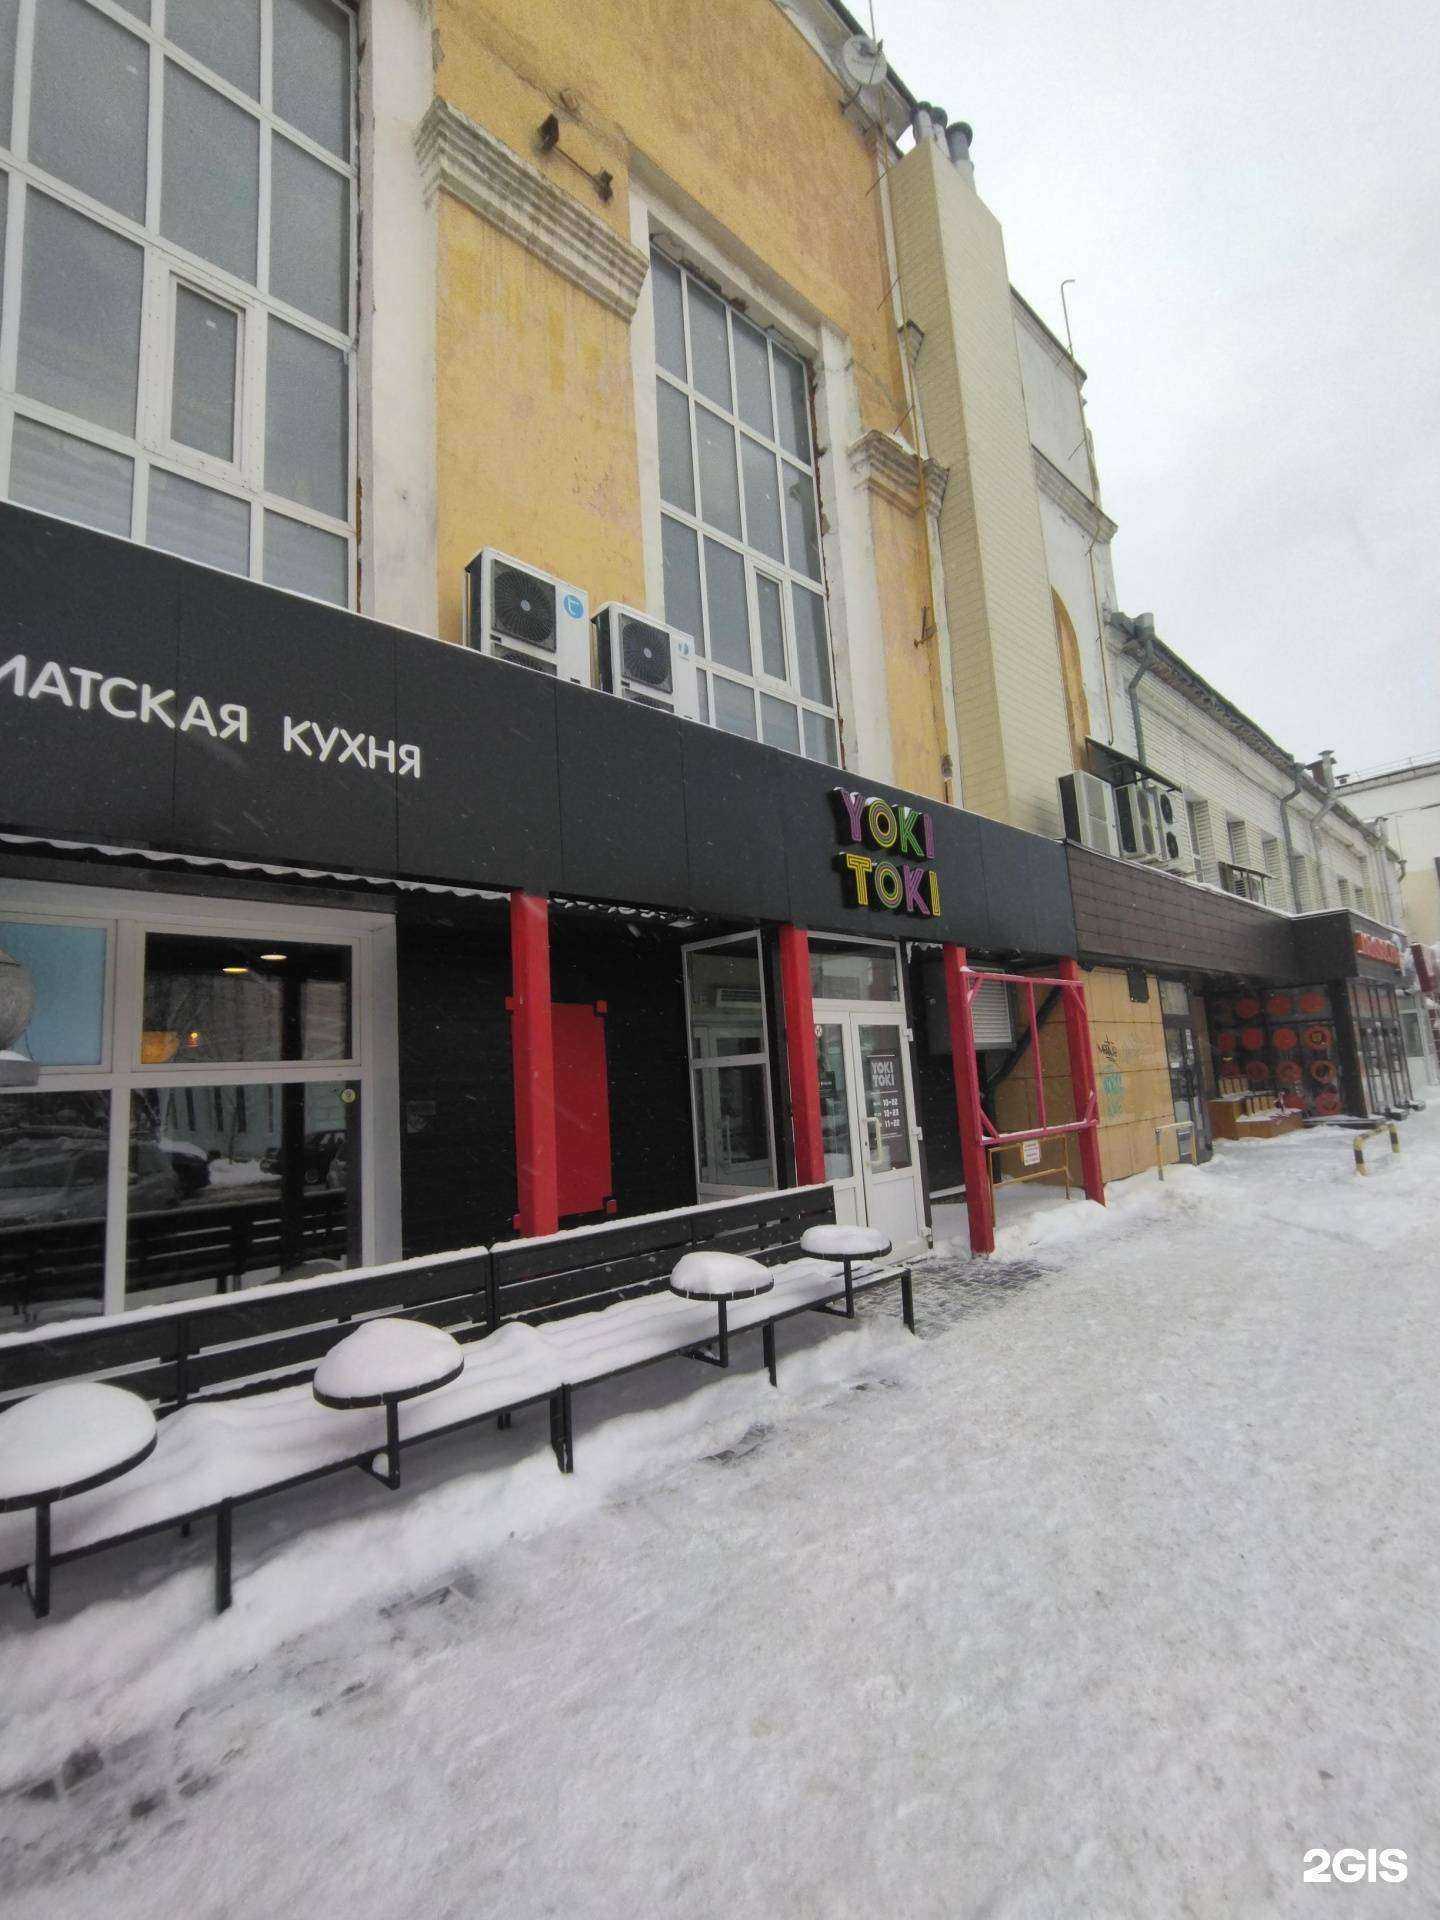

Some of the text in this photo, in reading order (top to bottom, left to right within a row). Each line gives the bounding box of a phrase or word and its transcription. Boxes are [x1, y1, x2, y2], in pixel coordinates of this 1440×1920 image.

[283, 716, 421, 779] КУХНЯ
[839, 788, 936, 859] YOKI
[845, 853, 941, 917] TOKI
[871, 1061, 894, 1074] YOKI
[872, 1073, 895, 1087] TOKI
